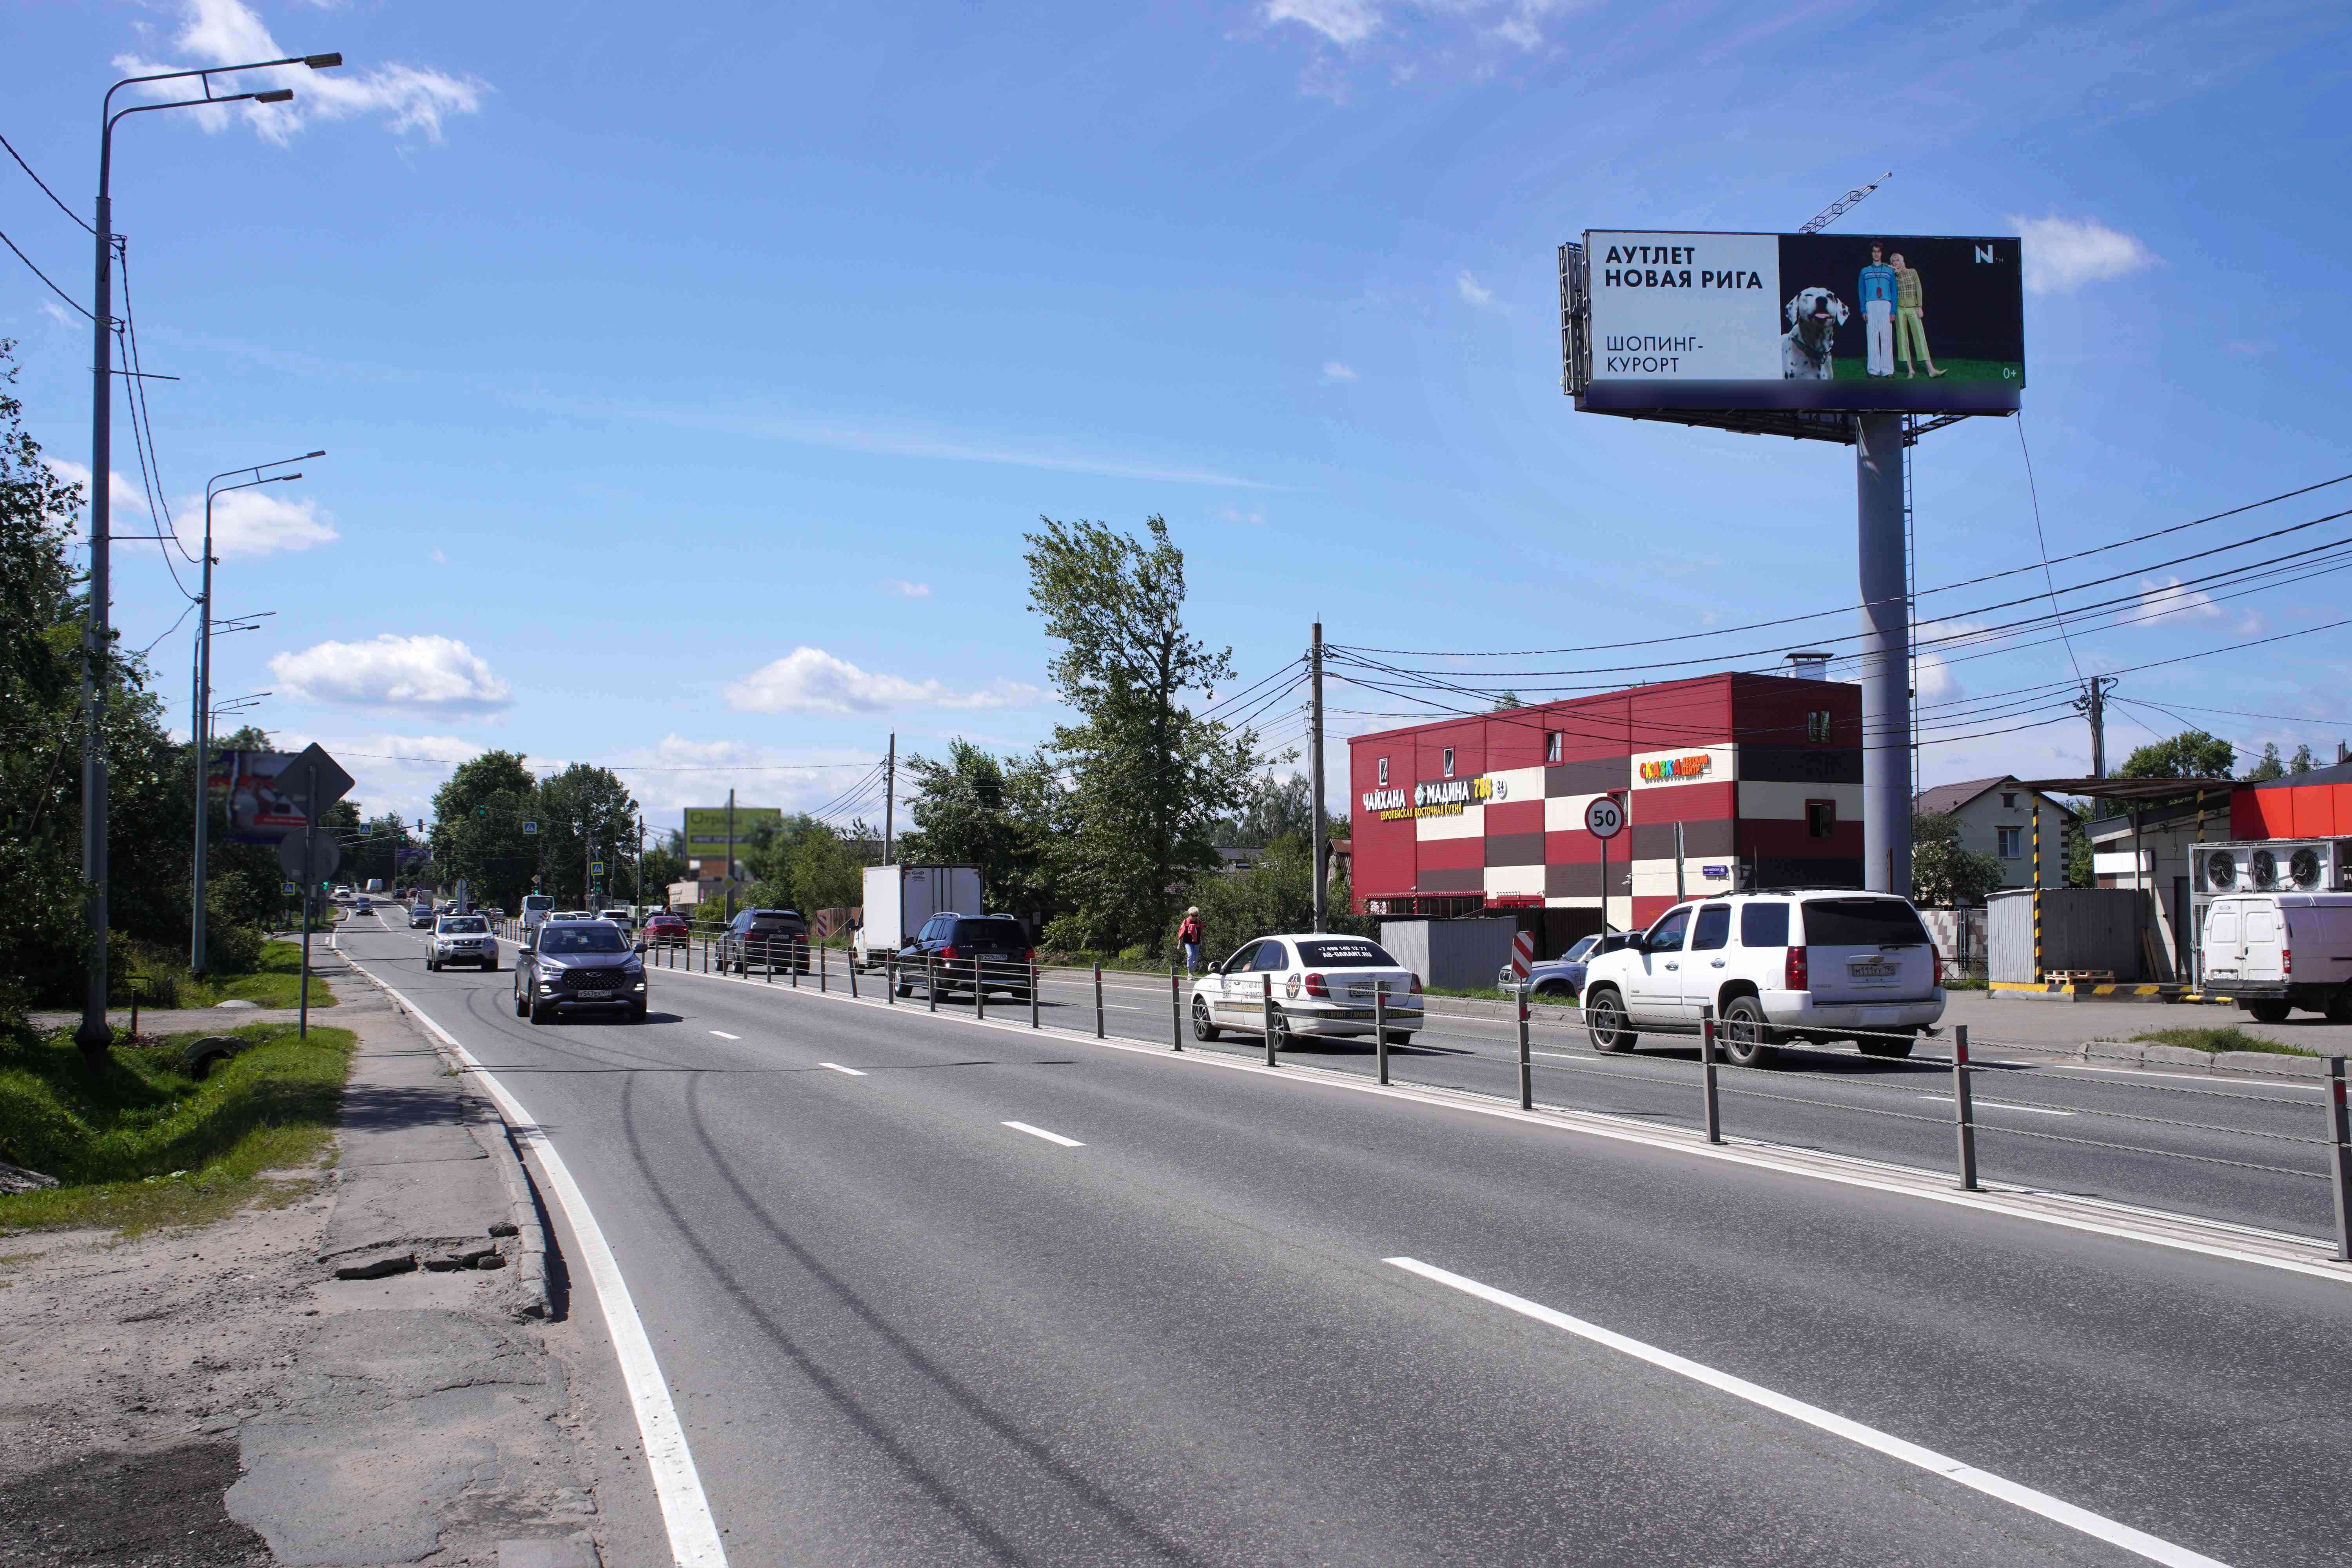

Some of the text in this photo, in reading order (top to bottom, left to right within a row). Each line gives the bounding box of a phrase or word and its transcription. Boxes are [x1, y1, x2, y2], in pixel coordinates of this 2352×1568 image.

[1606, 246, 1695, 264] АУТЛЕТ
[1606, 269, 1763, 289] НОВАЯ РИГА
[1607, 336, 1703, 352] ШОПИНГ-
[1607, 357, 1679, 372] КУРОРТ
[2004, 368, 2017, 379] 0+
[1682, 753, 1709, 765] ДЕТСКИЙ
[1639, 759, 1682, 779] СКАЗКА
[1681, 765, 1700, 775] ЦЕНТР
[1497, 780, 1504, 790] 24
[1363, 778, 1492, 811] ЧАЙХАНА МАДИНА 786
[1381, 804, 1462, 820] ЕВРОПЕЙСКАЯ ВОСТОЧНАЯ КУХНЯ
[1593, 810, 1616, 827] 50
